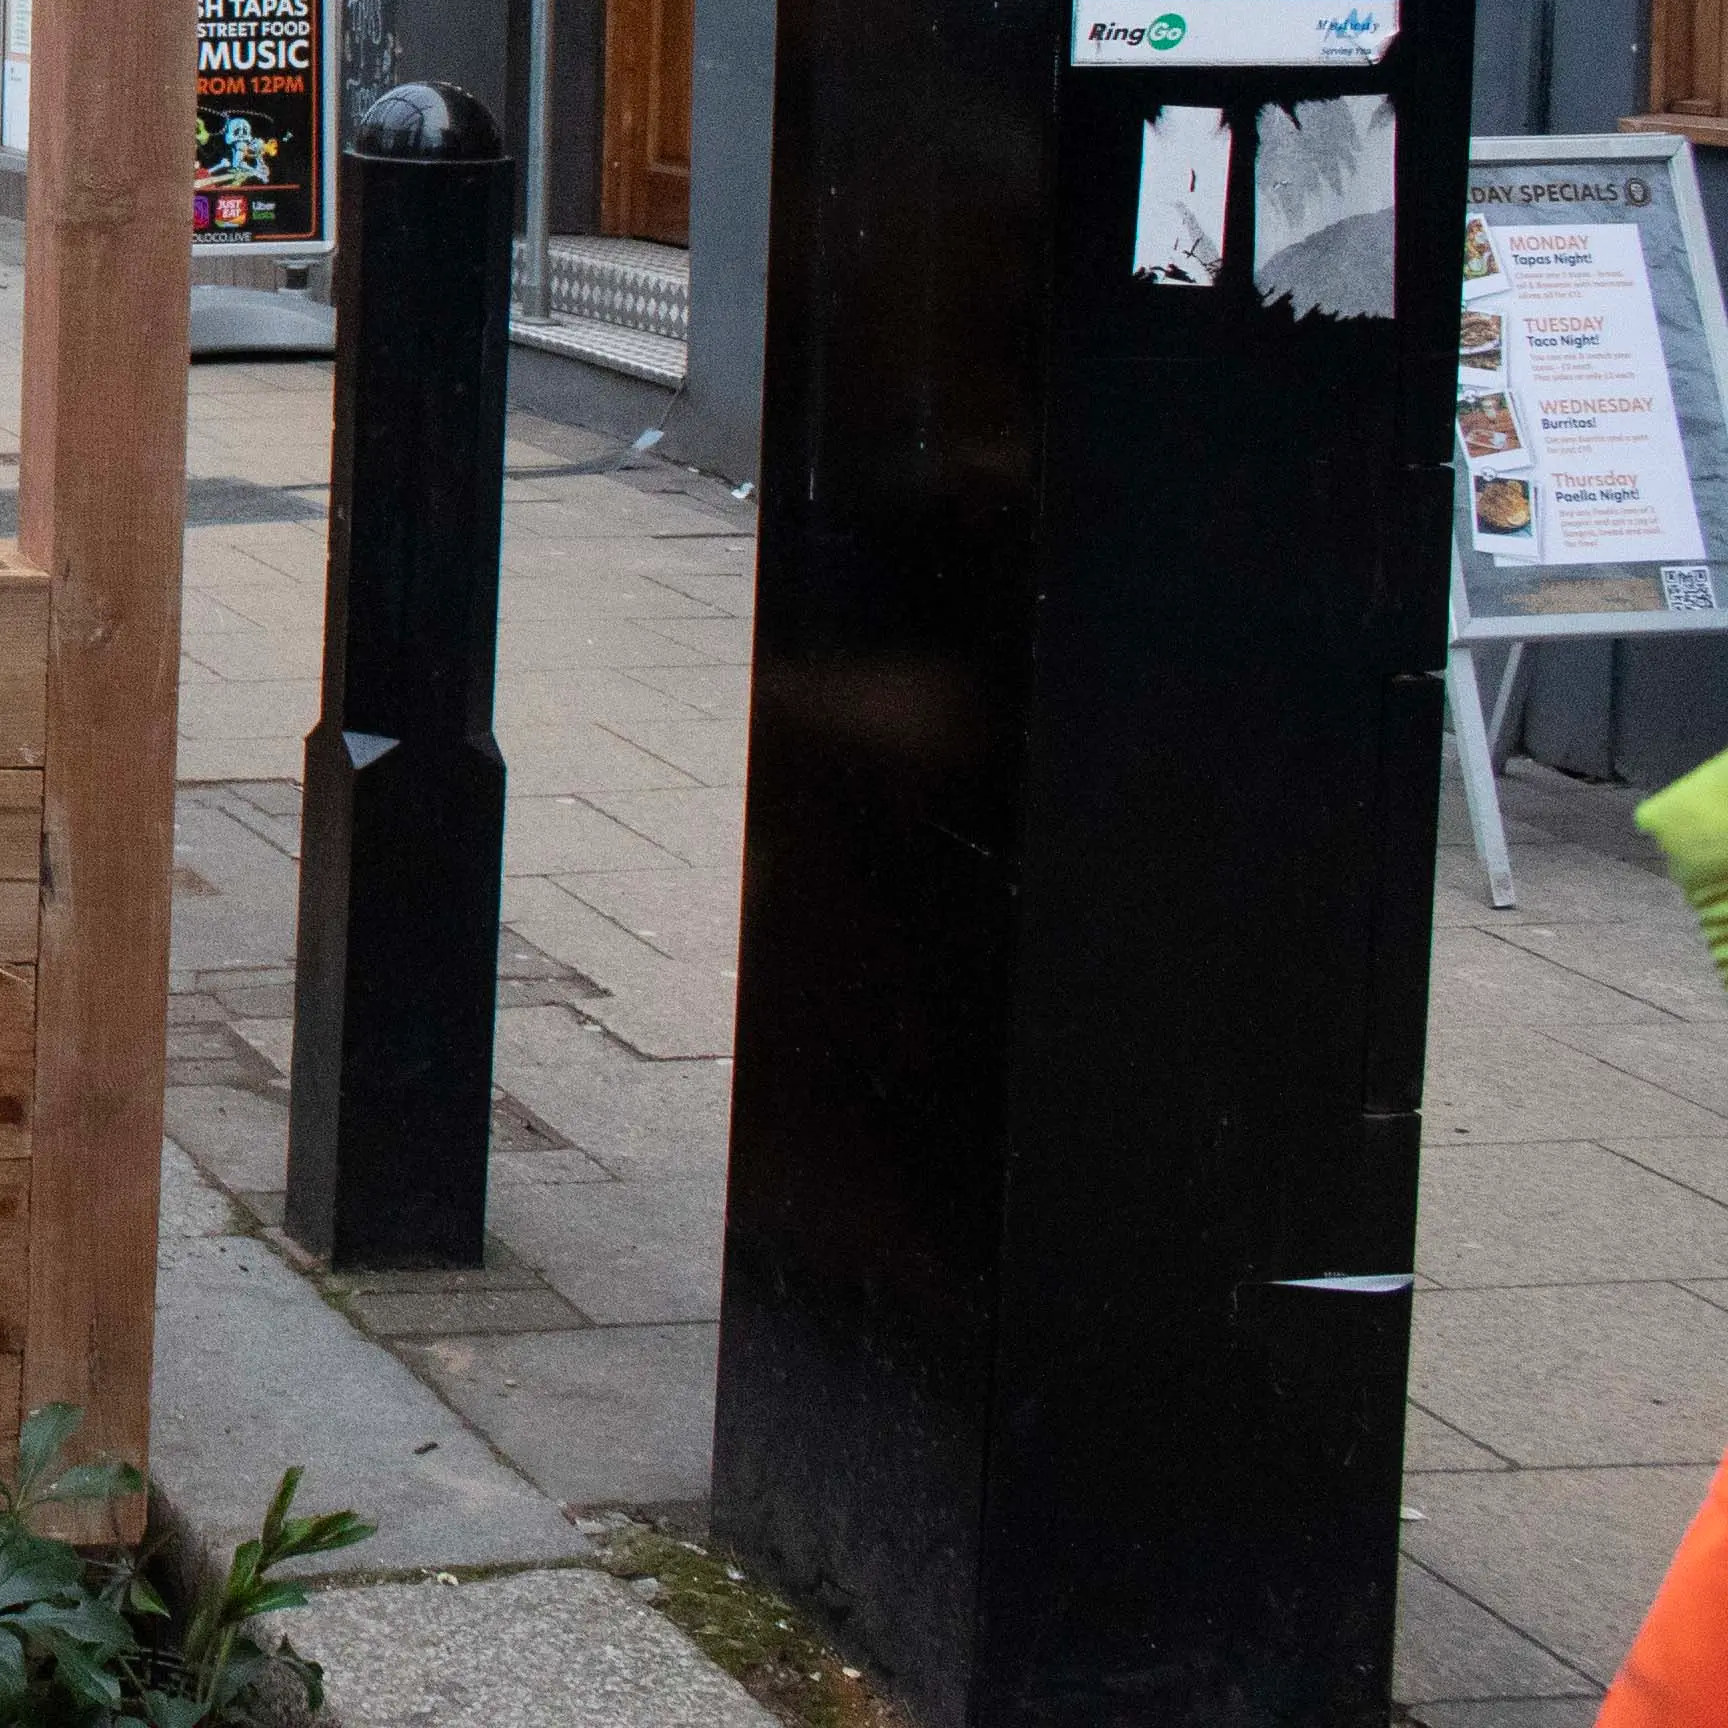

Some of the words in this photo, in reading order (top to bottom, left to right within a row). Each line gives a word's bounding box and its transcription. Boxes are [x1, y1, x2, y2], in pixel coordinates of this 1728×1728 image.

[197, 21, 258, 38] STREET
[262, 20, 310, 37] FOOD
[1088, 21, 1184, 46] RingGo
[198, 40, 310, 71] MUSIC
[251, 74, 305, 94] 12PM
[1467, 186, 1514, 204] DAY
[1520, 183, 1618, 204] SPECIALS
[1509, 235, 1590, 252] MONDAY
[1512, 253, 1551, 267] Tapas
[1553, 253, 1593, 267] Night!
[1523, 316, 1605, 333] TUESDAY
[1526, 336, 1557, 347] Taco
[1560, 334, 1600, 348] Night!
[1538, 397, 1653, 414] WEDNESDAY
[1541, 417, 1596, 430] Burritos!
[1552, 470, 1638, 489] Thursday
[1555, 490, 1598, 503] Paella
[1600, 488, 1640, 503] Night!
